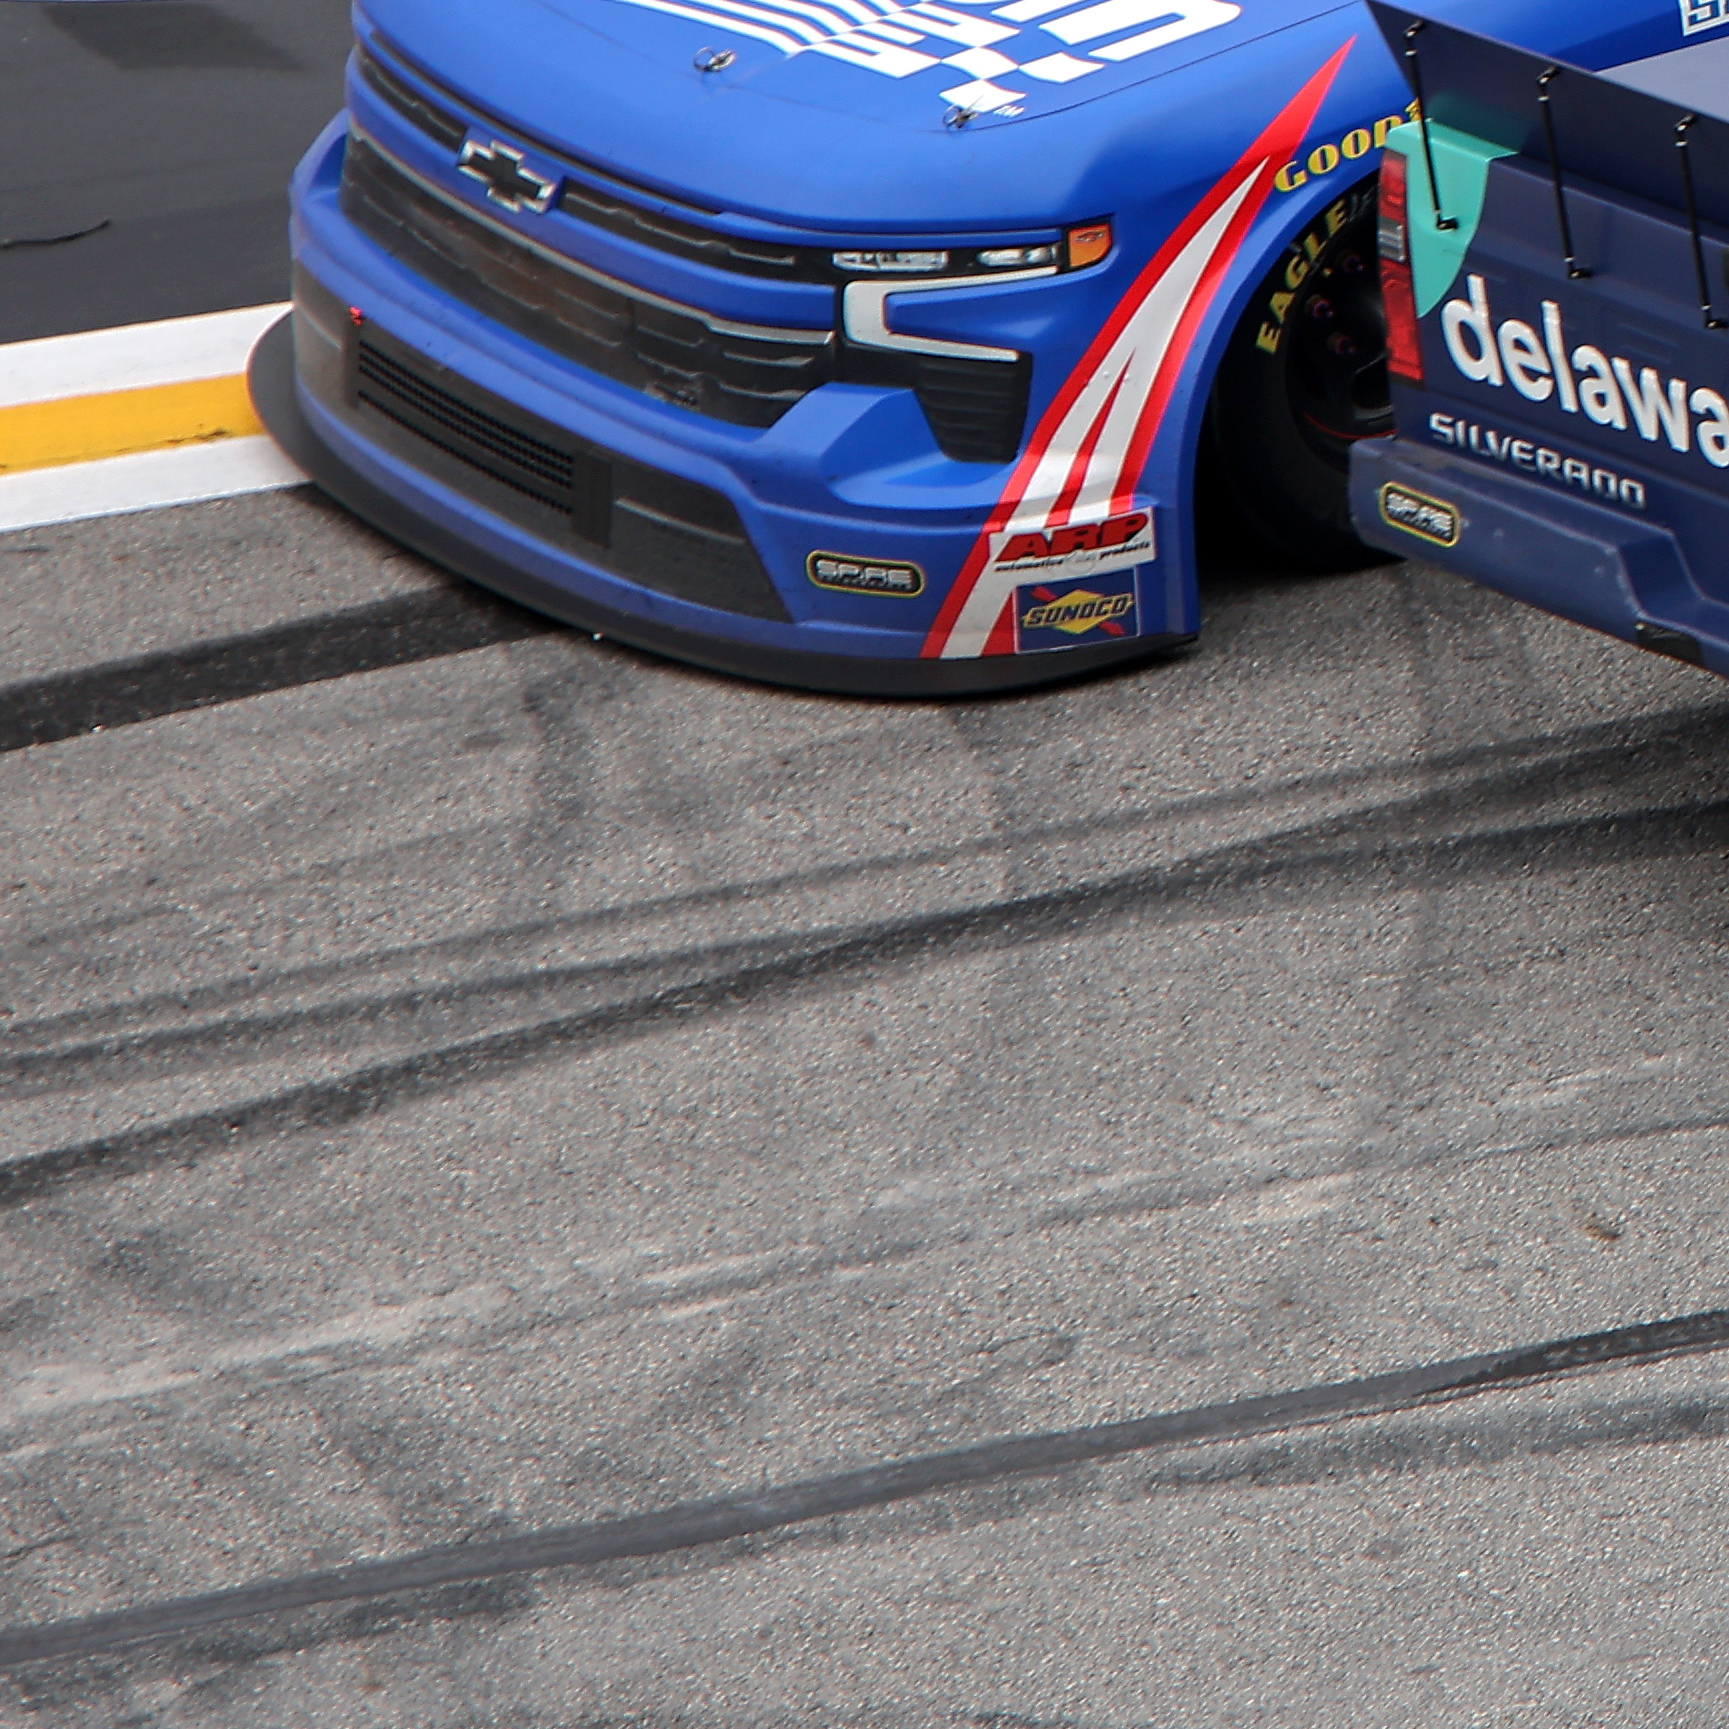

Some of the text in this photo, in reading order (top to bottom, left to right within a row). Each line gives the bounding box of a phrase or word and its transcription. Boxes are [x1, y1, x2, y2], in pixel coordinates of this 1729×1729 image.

[1256, 198, 1349, 355] EAGLE
[1428, 410, 1648, 512] SILVERADO
[996, 513, 1149, 562] ARP
[1024, 593, 1133, 628] SUNOCO
